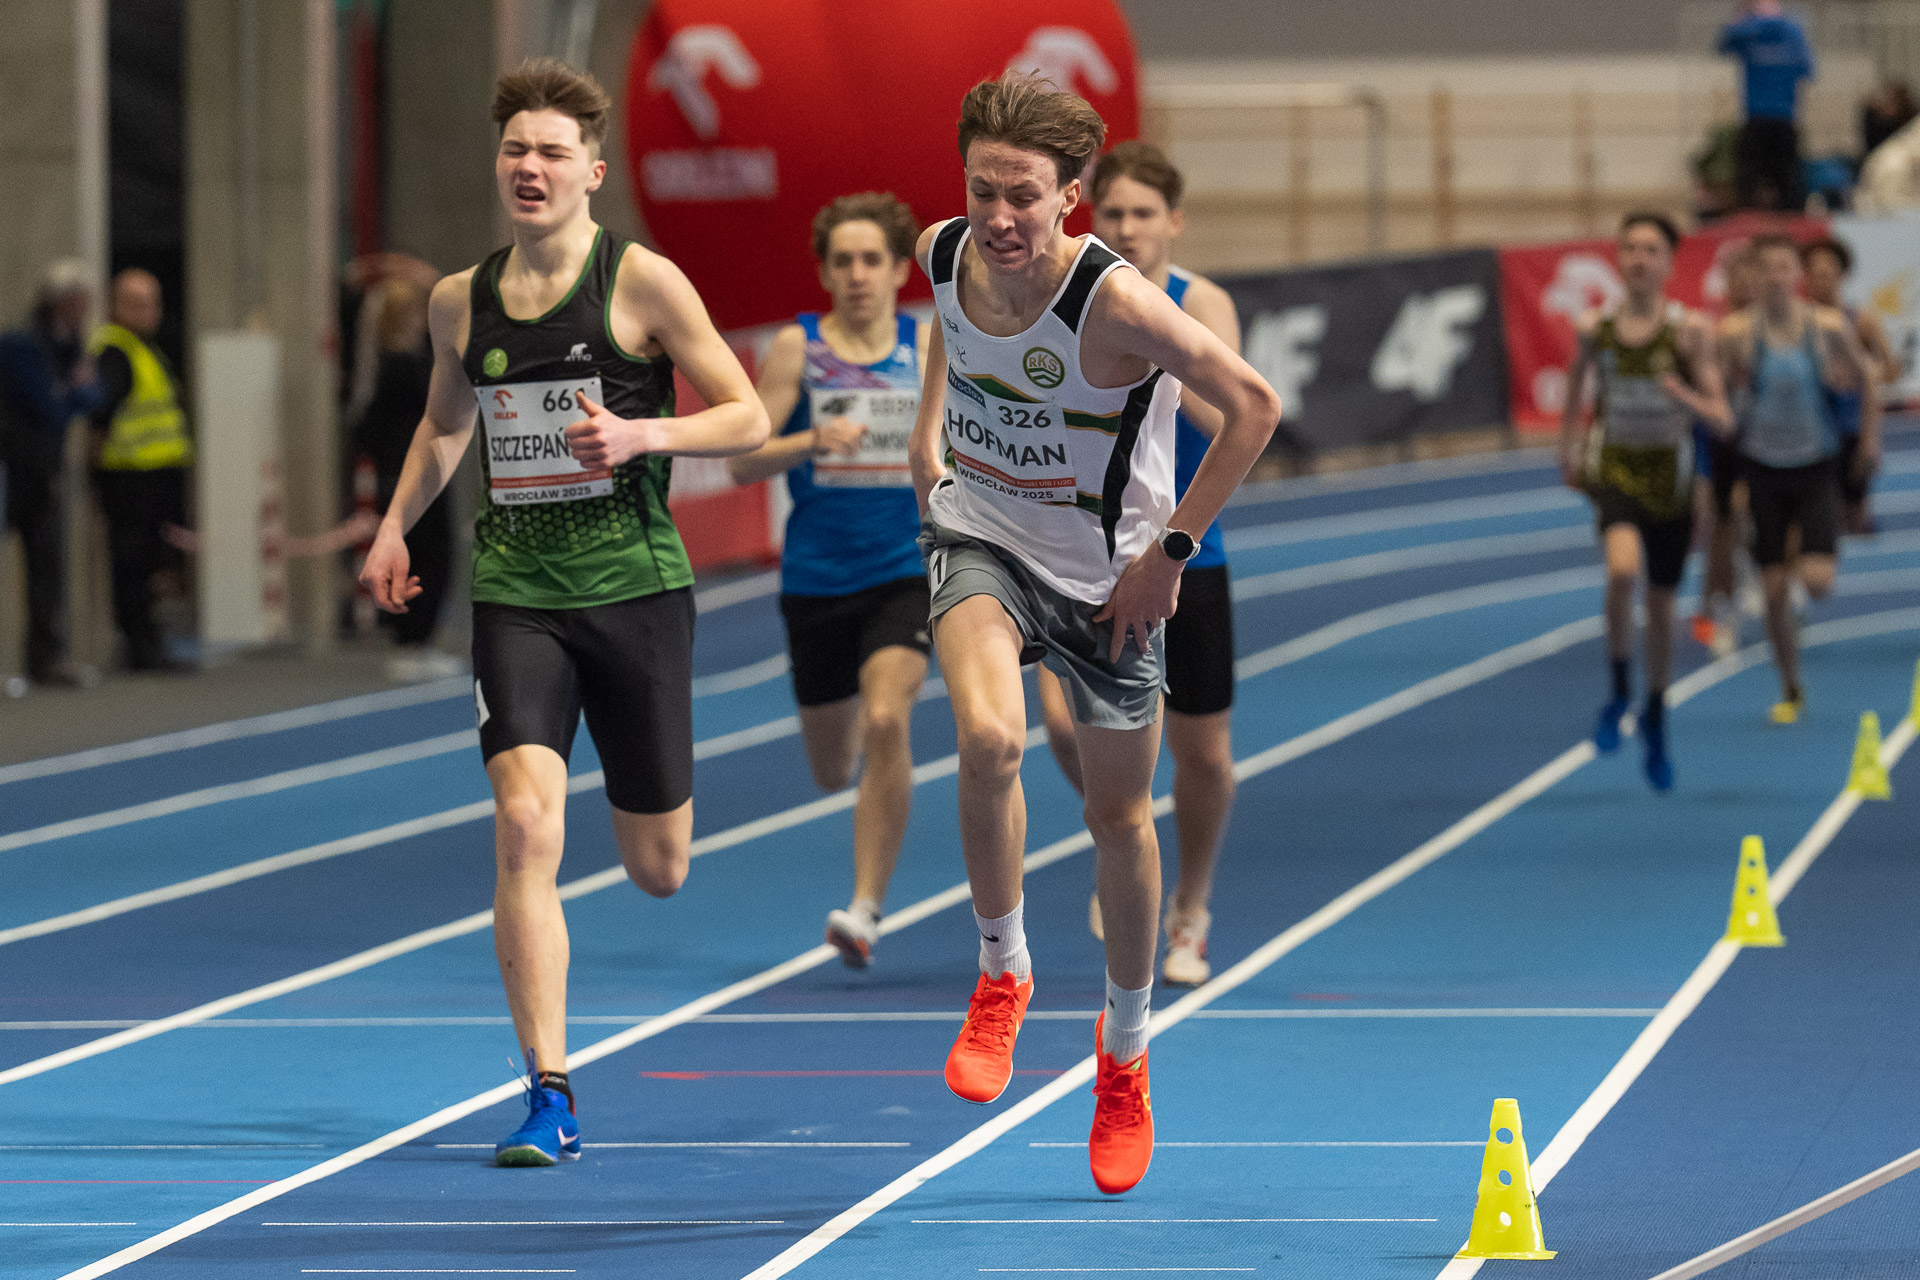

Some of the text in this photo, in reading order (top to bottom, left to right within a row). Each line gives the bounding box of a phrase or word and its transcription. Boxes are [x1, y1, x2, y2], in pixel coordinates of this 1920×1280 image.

[1368, 285, 1486, 398] 4F
[1029, 353, 1058, 372] RKS
[543, 387, 585, 412] 66
[997, 405, 1051, 429] 326
[947, 408, 1067, 467] HOFMAN
[562, 485, 592, 498] 2025
[960, 467, 1054, 499] WROCŁAW 2025
